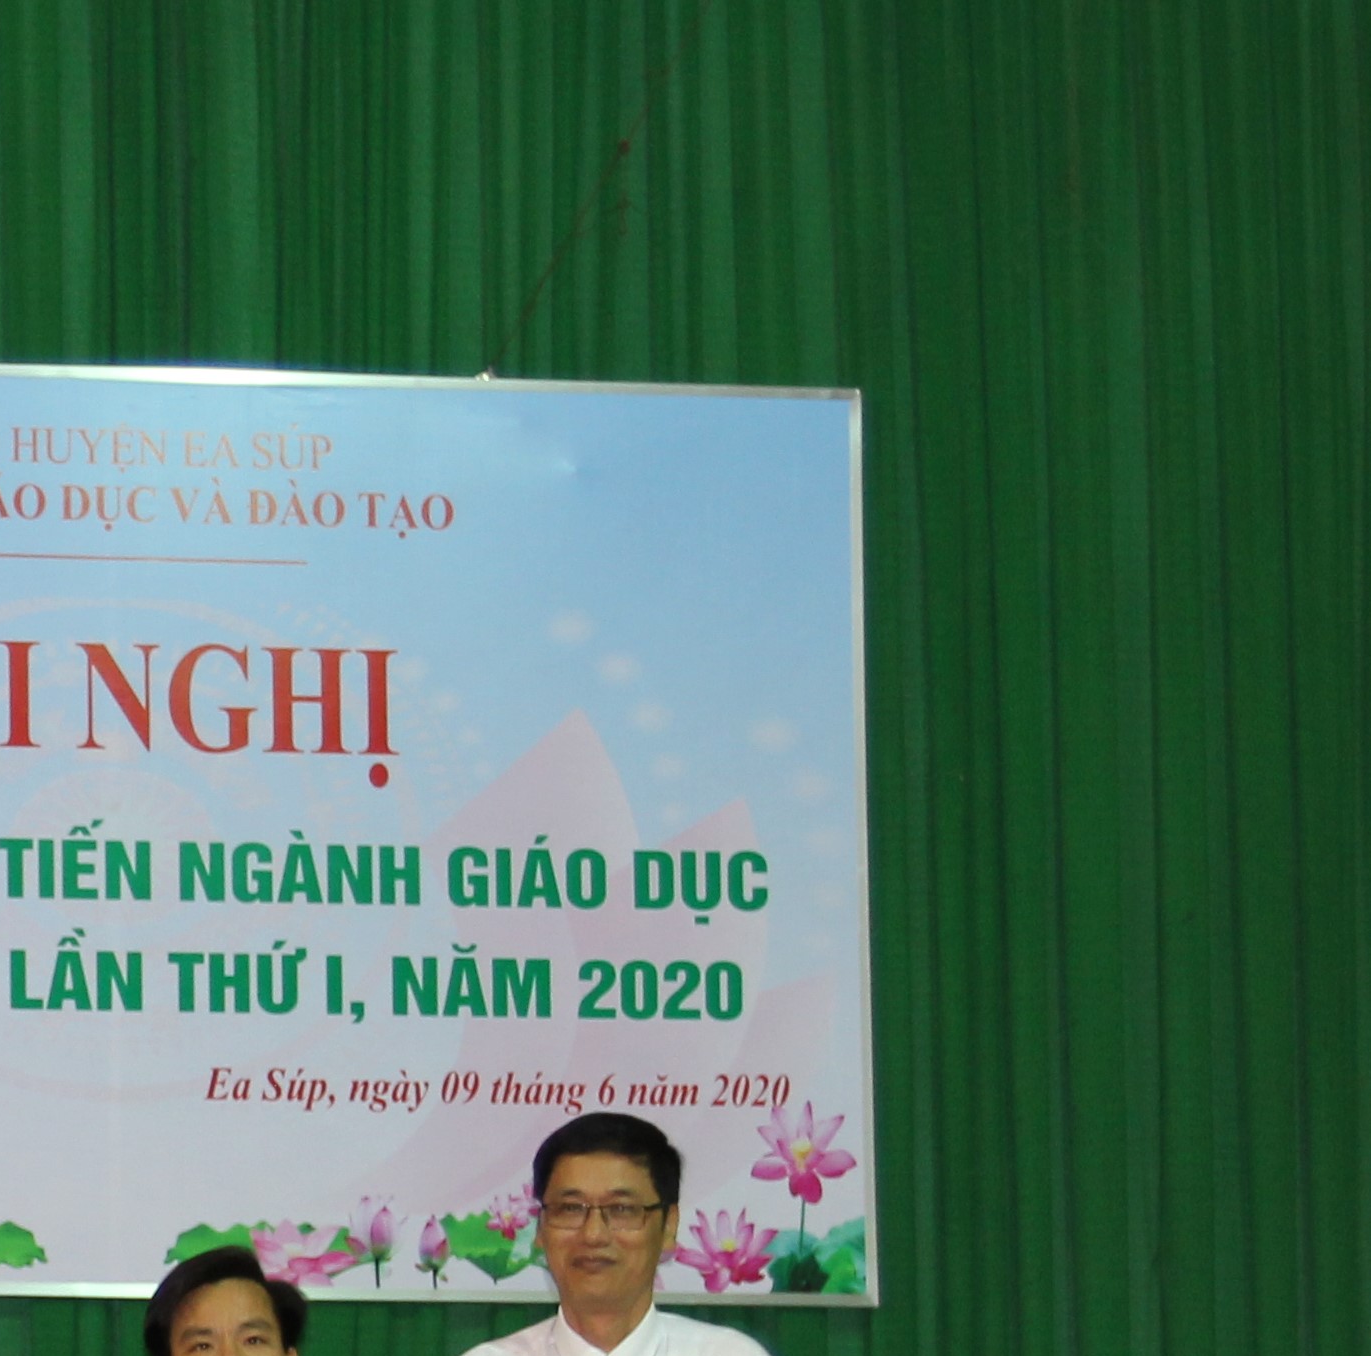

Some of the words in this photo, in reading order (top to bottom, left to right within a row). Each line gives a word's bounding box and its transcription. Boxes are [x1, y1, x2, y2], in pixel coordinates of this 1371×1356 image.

[11, 422, 167, 474] HUYỆN
[183, 430, 241, 469] EA
[250, 422, 333, 472] SÚP
[61, 483, 157, 532] DỤC
[169, 476, 233, 526] VÀ
[247, 479, 346, 528] ĐÀO
[358, 492, 455, 539] TẠO
[75, 642, 399, 789] NGHỊ
[179, 829, 422, 906] NGÀNH
[447, 834, 608, 910] GIÁO
[633, 849, 770, 925] DỤC
[9, 928, 144, 1012] LẦN
[167, 939, 309, 1015] THỨ
[326, 954, 366, 1024] I,
[392, 944, 553, 1018] NĂM
[578, 958, 744, 1022] 2020
[206, 1067, 252, 1101] Ea
[261, 1067, 337, 1112] Súp,
[349, 1069, 430, 1113] ngày
[441, 1070, 480, 1104] 09
[490, 1072, 588, 1116] tháng
[597, 1073, 617, 1106] 6
[627, 1074, 700, 1106] năm
[710, 1073, 791, 1107] 2020
